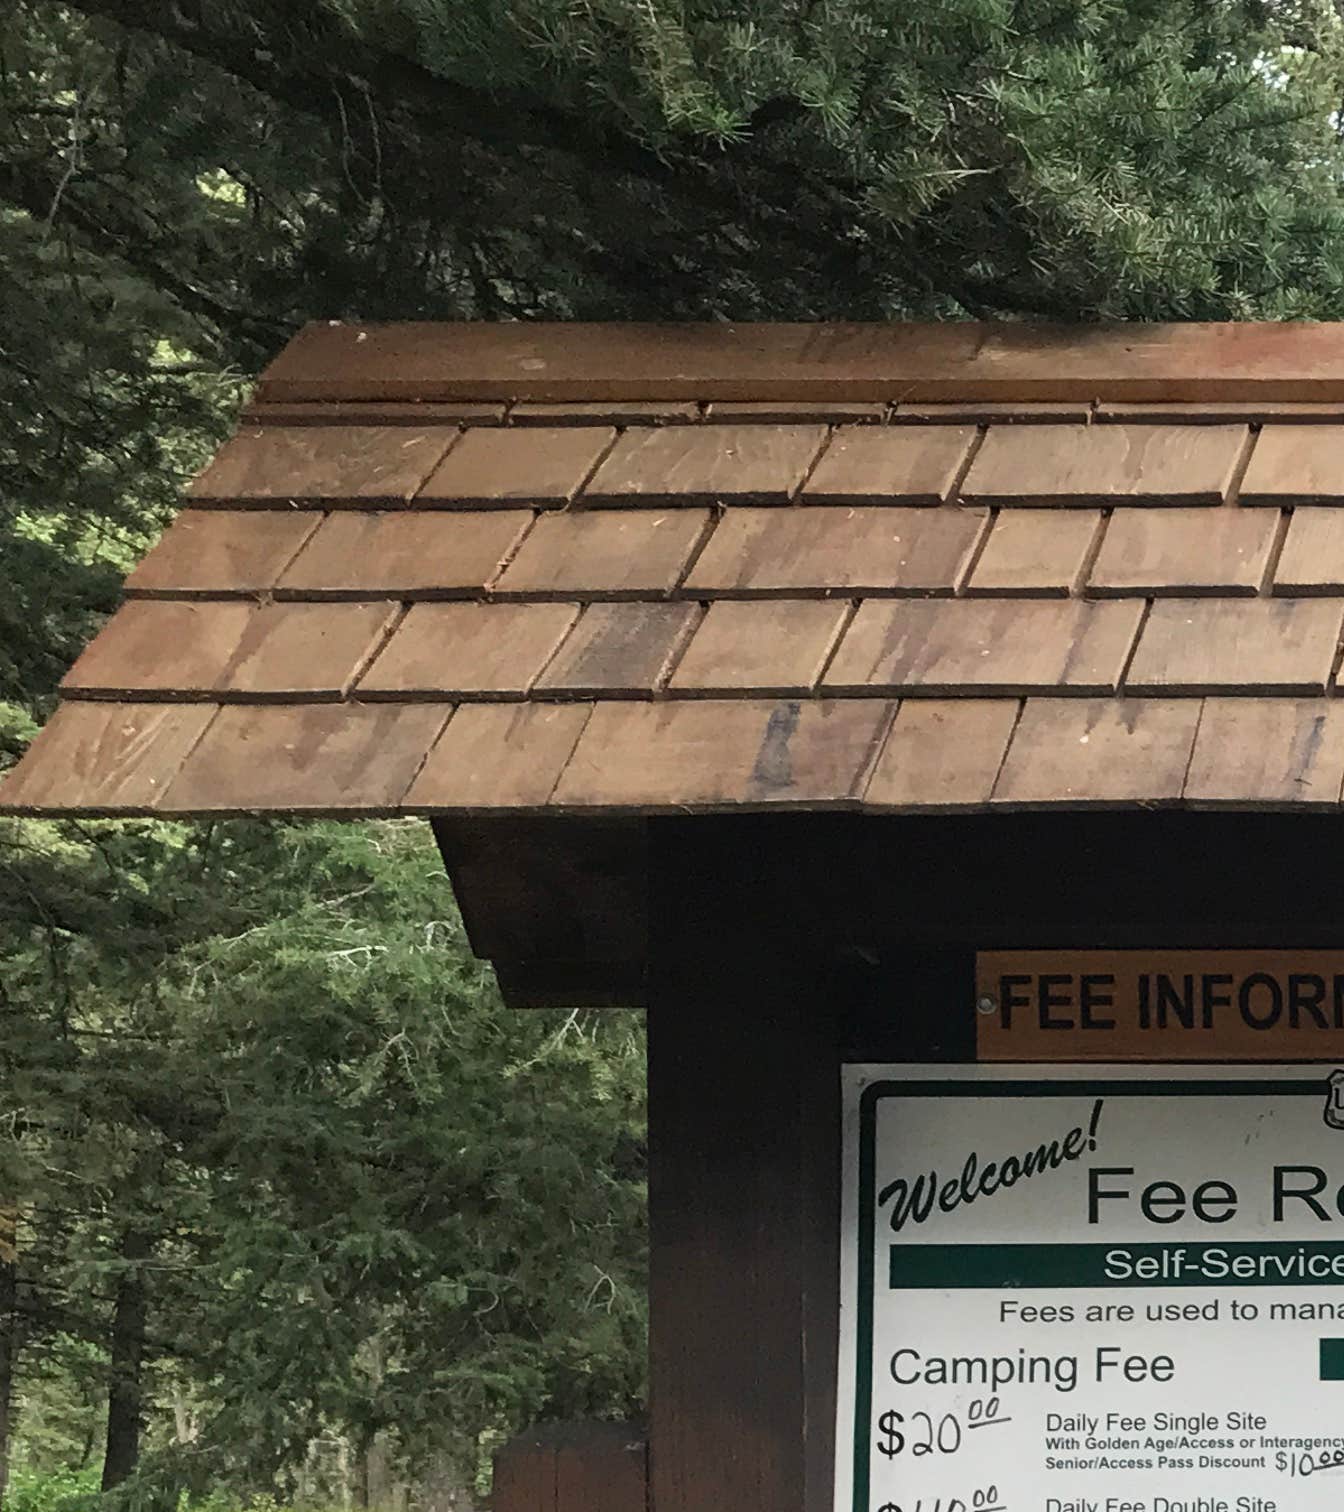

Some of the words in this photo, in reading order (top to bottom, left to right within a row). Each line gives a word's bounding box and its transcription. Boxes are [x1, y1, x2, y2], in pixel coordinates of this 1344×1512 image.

[998, 974, 1116, 1030] FEE
[879, 1099, 1103, 1232] Welcome!
[1088, 1167, 1238, 1224] Fee
[1000, 1301, 1074, 1322] Fees
[1086, 1305, 1134, 1322] are
[1147, 1299, 1218, 1321] used
[1230, 1300, 1258, 1320] to
[890, 1348, 1077, 1391] Camping
[1096, 1347, 1174, 1382] Fee
[1047, 1414, 1098, 1436] Daily
[1107, 1413, 1146, 1431] Fee
[1154, 1413, 1218, 1435] Single
[1227, 1412, 1266, 1430] Site
